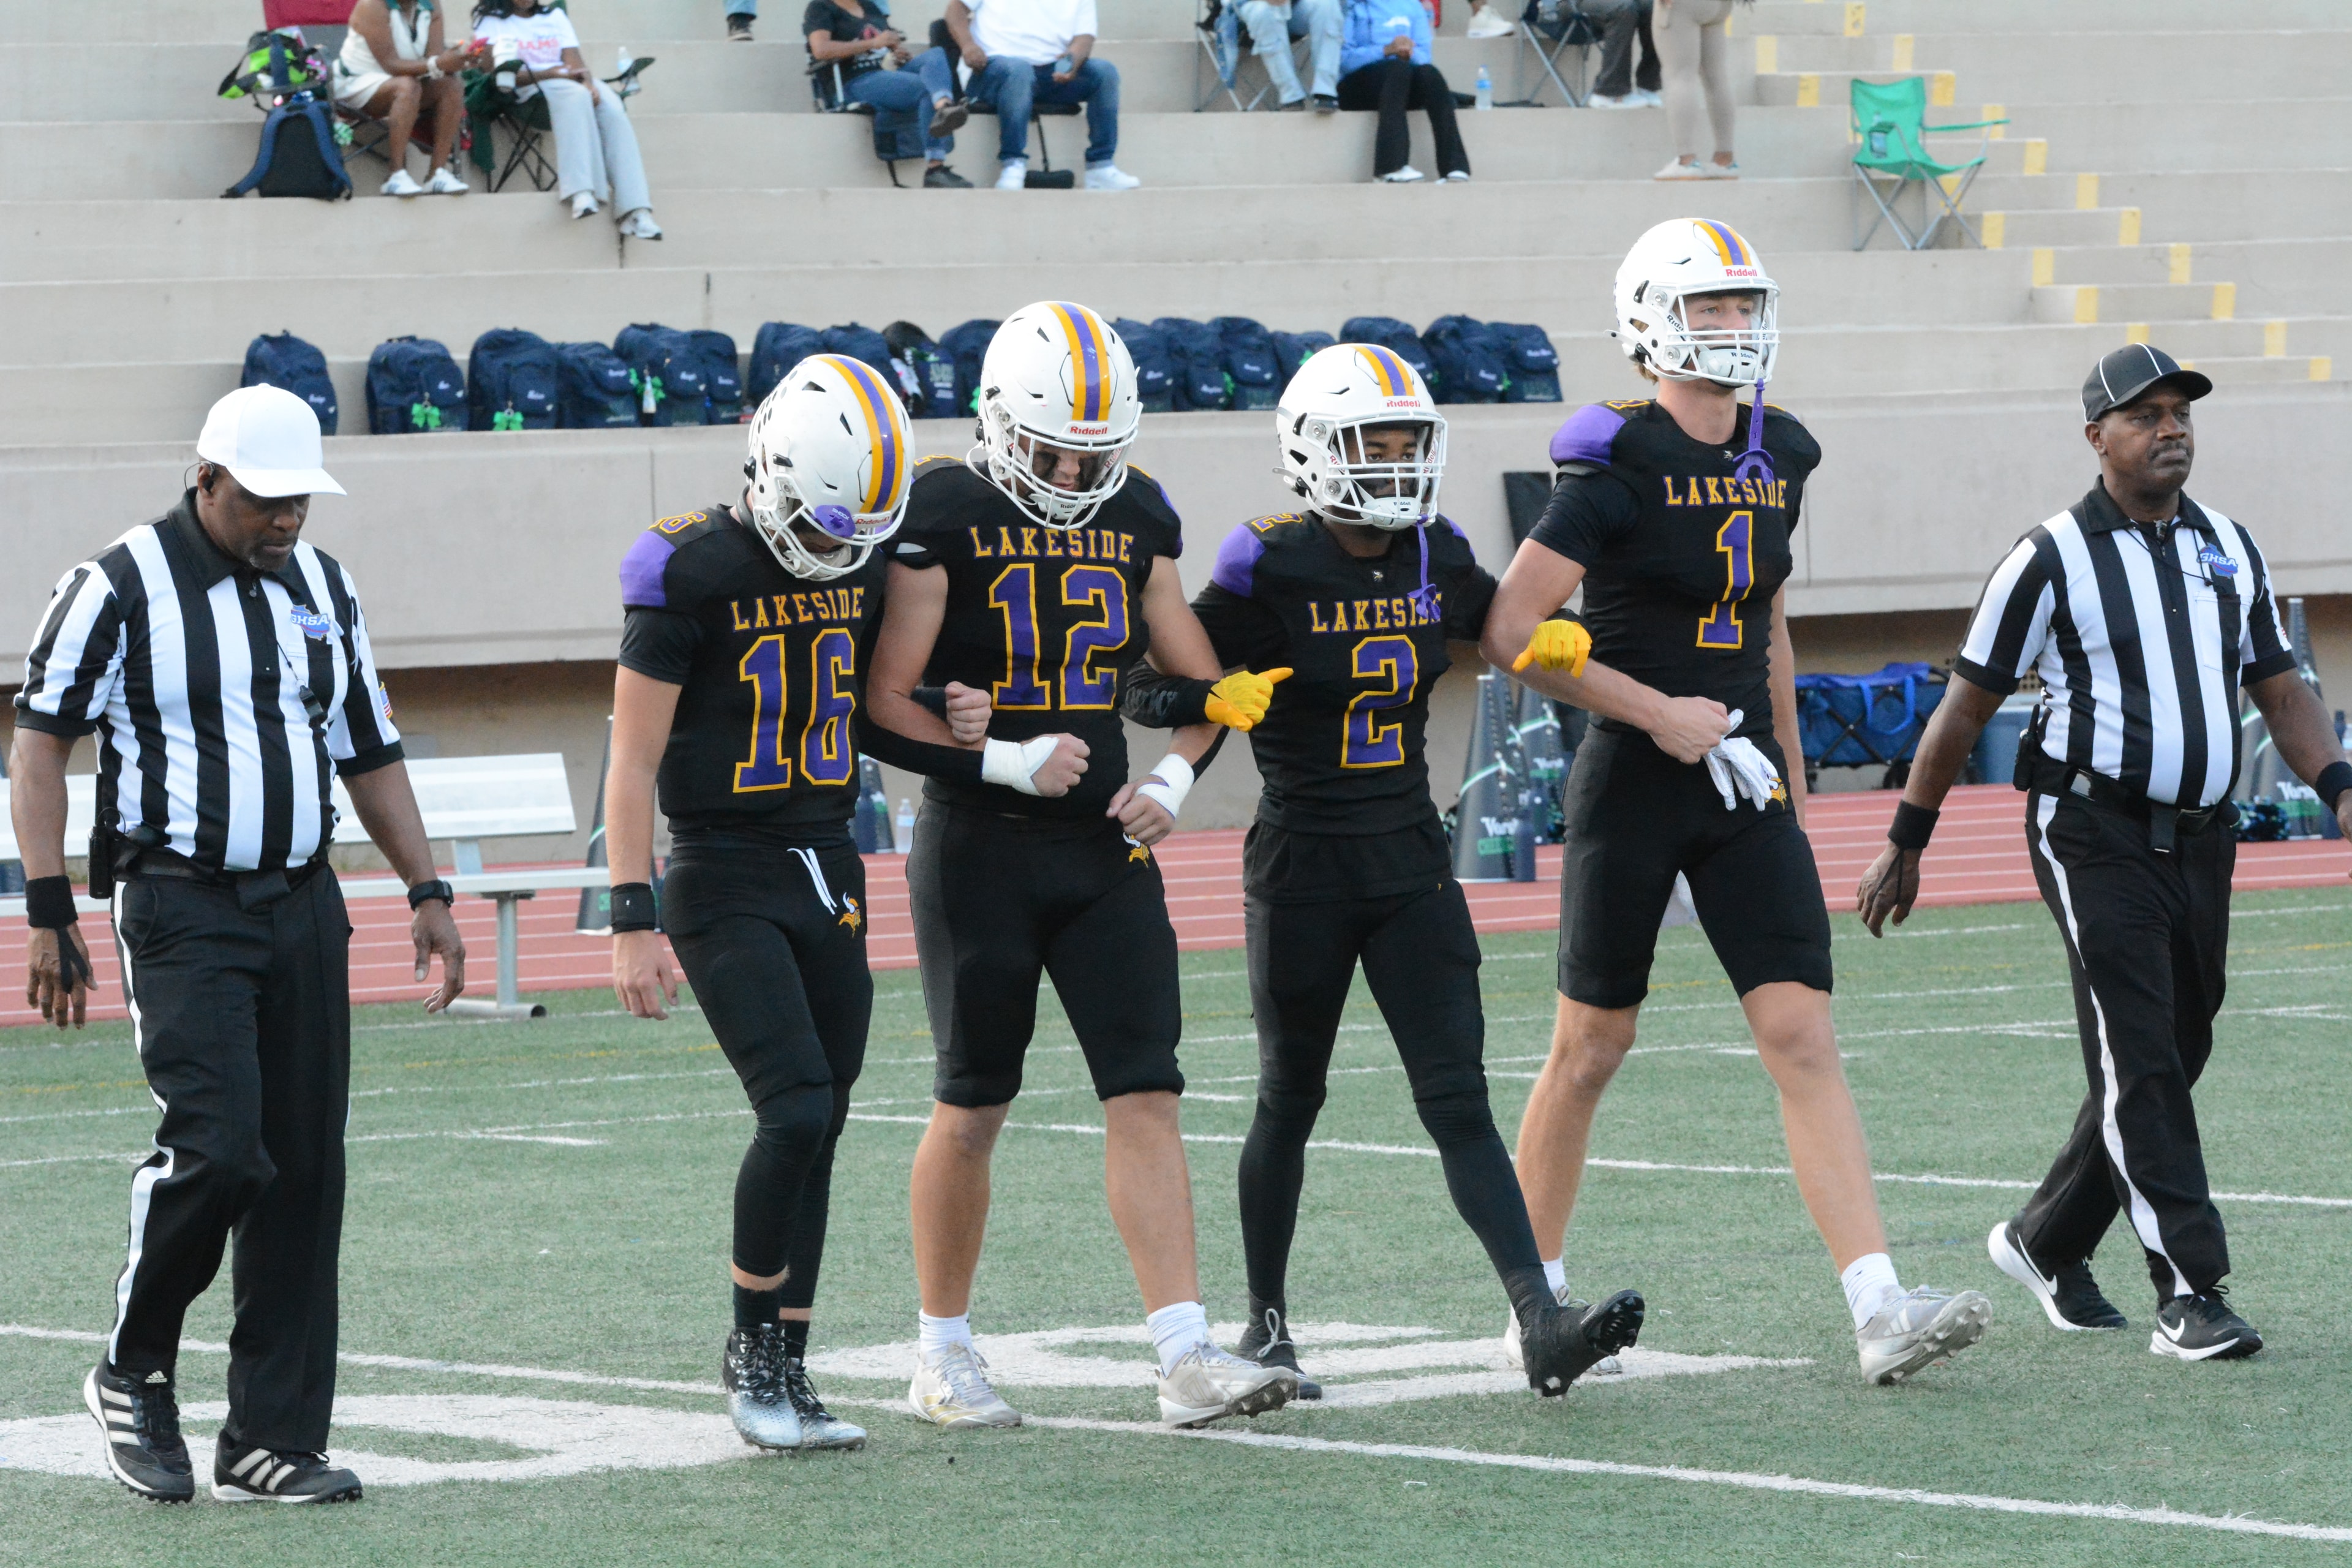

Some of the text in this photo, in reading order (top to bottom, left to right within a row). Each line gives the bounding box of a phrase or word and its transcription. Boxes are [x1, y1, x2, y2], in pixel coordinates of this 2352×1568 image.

[1069, 426, 1108, 435] Riddell
[1662, 475, 1788, 510] LAKESIDE
[968, 525, 1135, 565] LAKESIDE
[2198, 552, 2237, 567] GHSA
[1695, 510, 1754, 649] 1
[291, 614, 330, 625] GHSA
[729, 586, 865, 633] LAKESIDE
[1308, 591, 1442, 634] LAKESI
[988, 563, 1129, 710] 12
[733, 627, 856, 793] 16
[1340, 635, 1419, 768] 2
